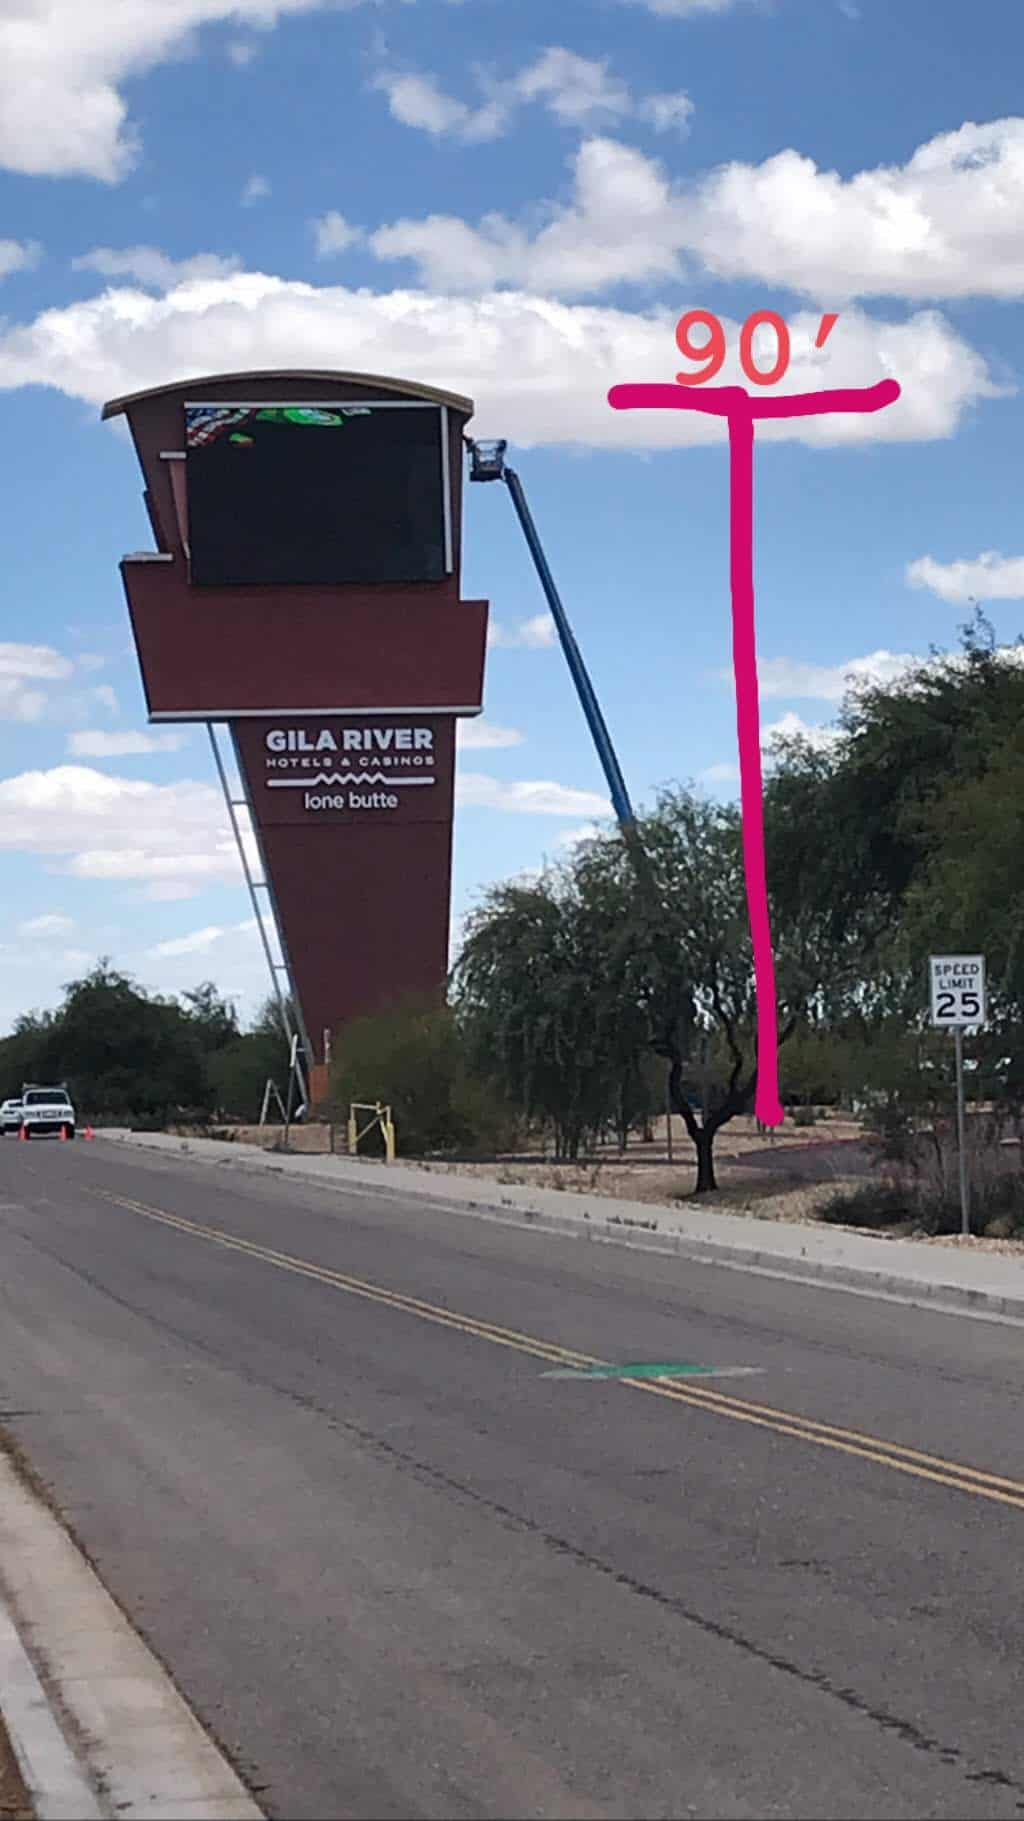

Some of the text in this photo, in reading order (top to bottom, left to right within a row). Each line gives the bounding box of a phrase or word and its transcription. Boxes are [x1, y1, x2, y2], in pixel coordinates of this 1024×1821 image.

[266, 728, 433, 751] GILA RIVER
[266, 756, 435, 768] HOTELS & CASINOS
[305, 791, 398, 809] lone butte
[934, 963, 980, 976] SPEED
[939, 978, 974, 990] LIMIT
[936, 992, 980, 1018] 25
